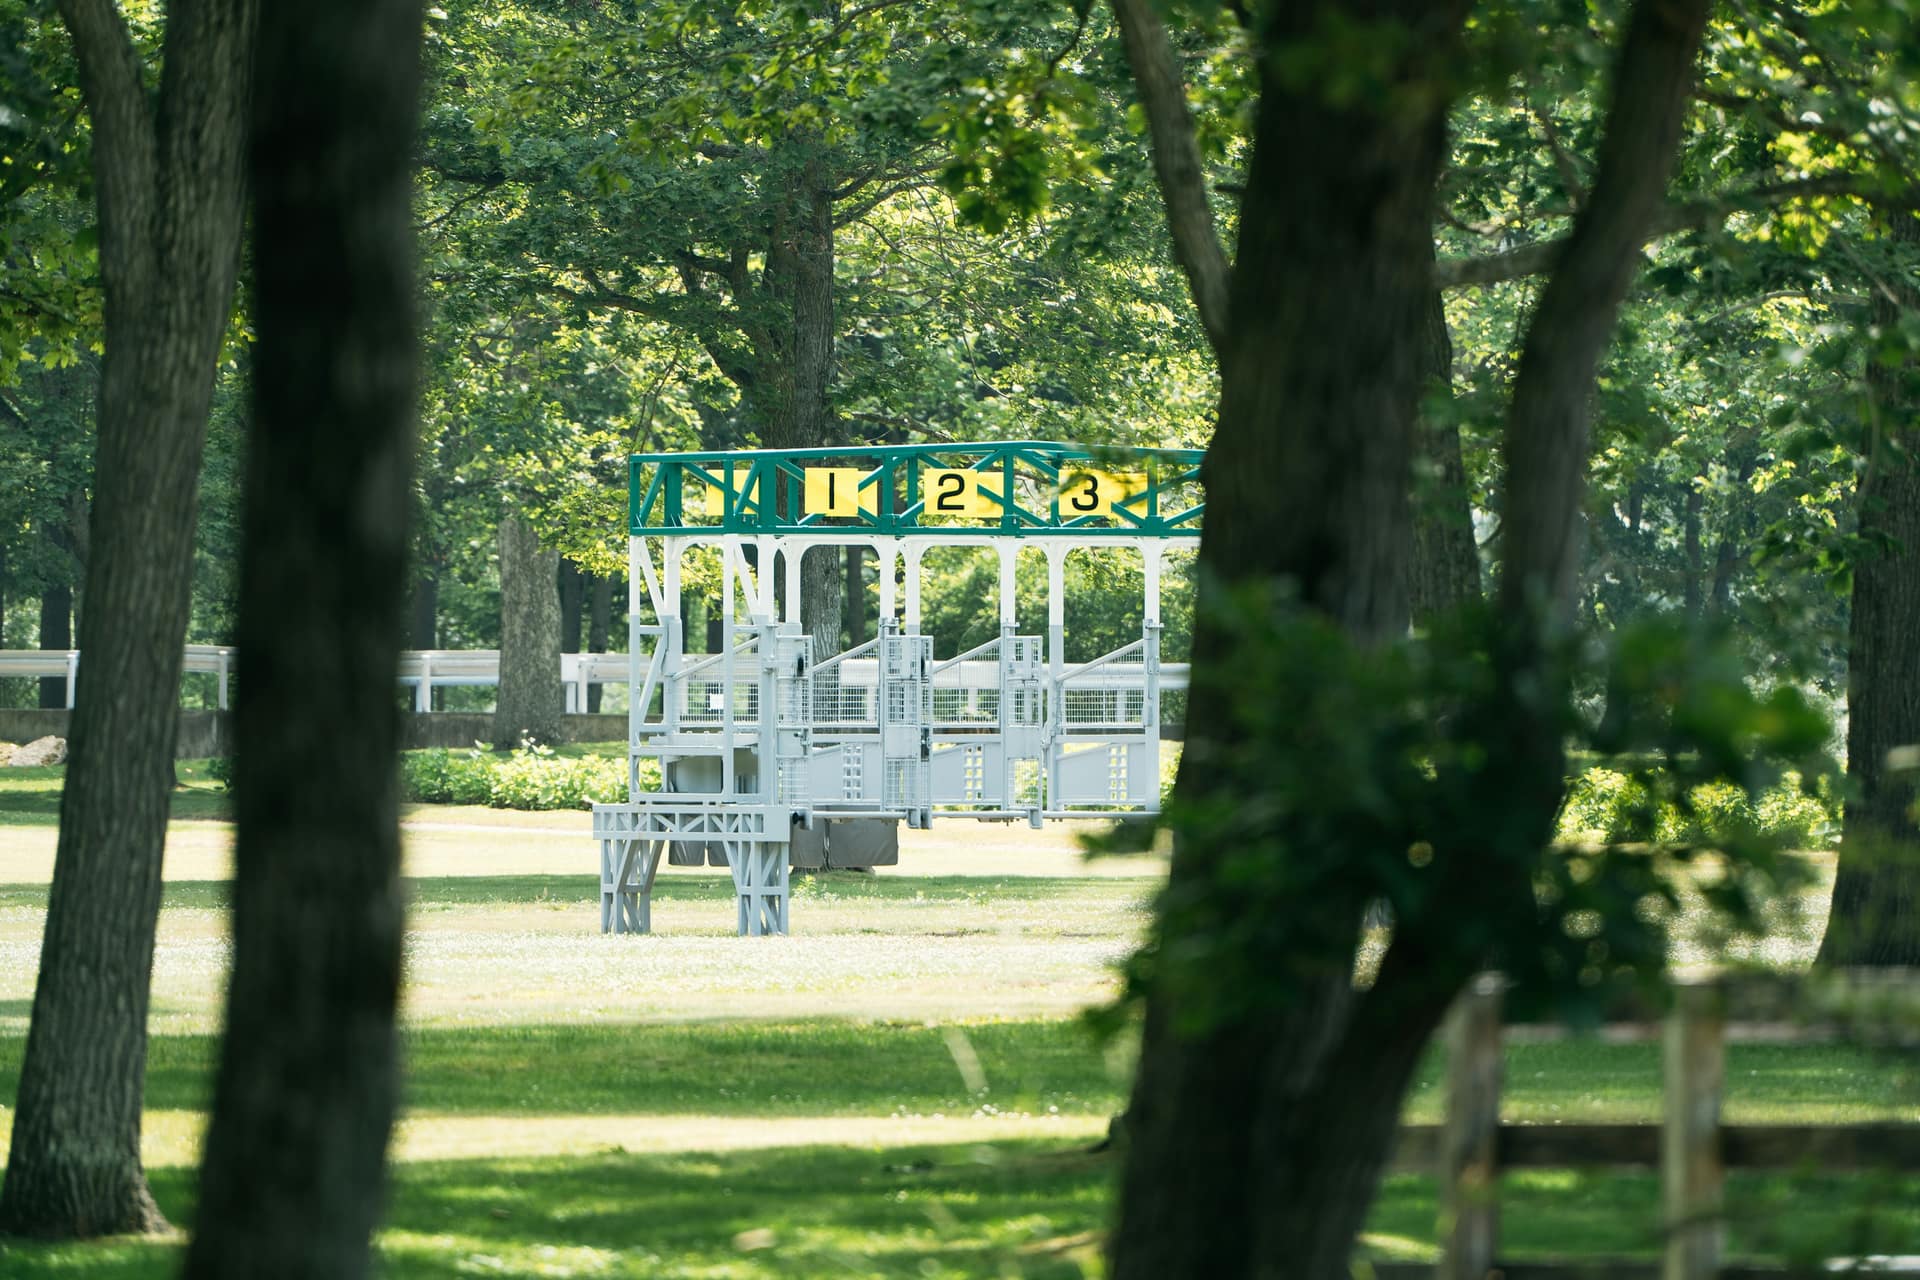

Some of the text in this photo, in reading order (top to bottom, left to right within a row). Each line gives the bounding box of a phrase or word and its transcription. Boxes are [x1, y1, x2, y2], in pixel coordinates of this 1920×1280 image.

[829, 472, 835, 510] 1
[937, 473, 965, 511] 2
[1071, 475, 1099, 511] 3
